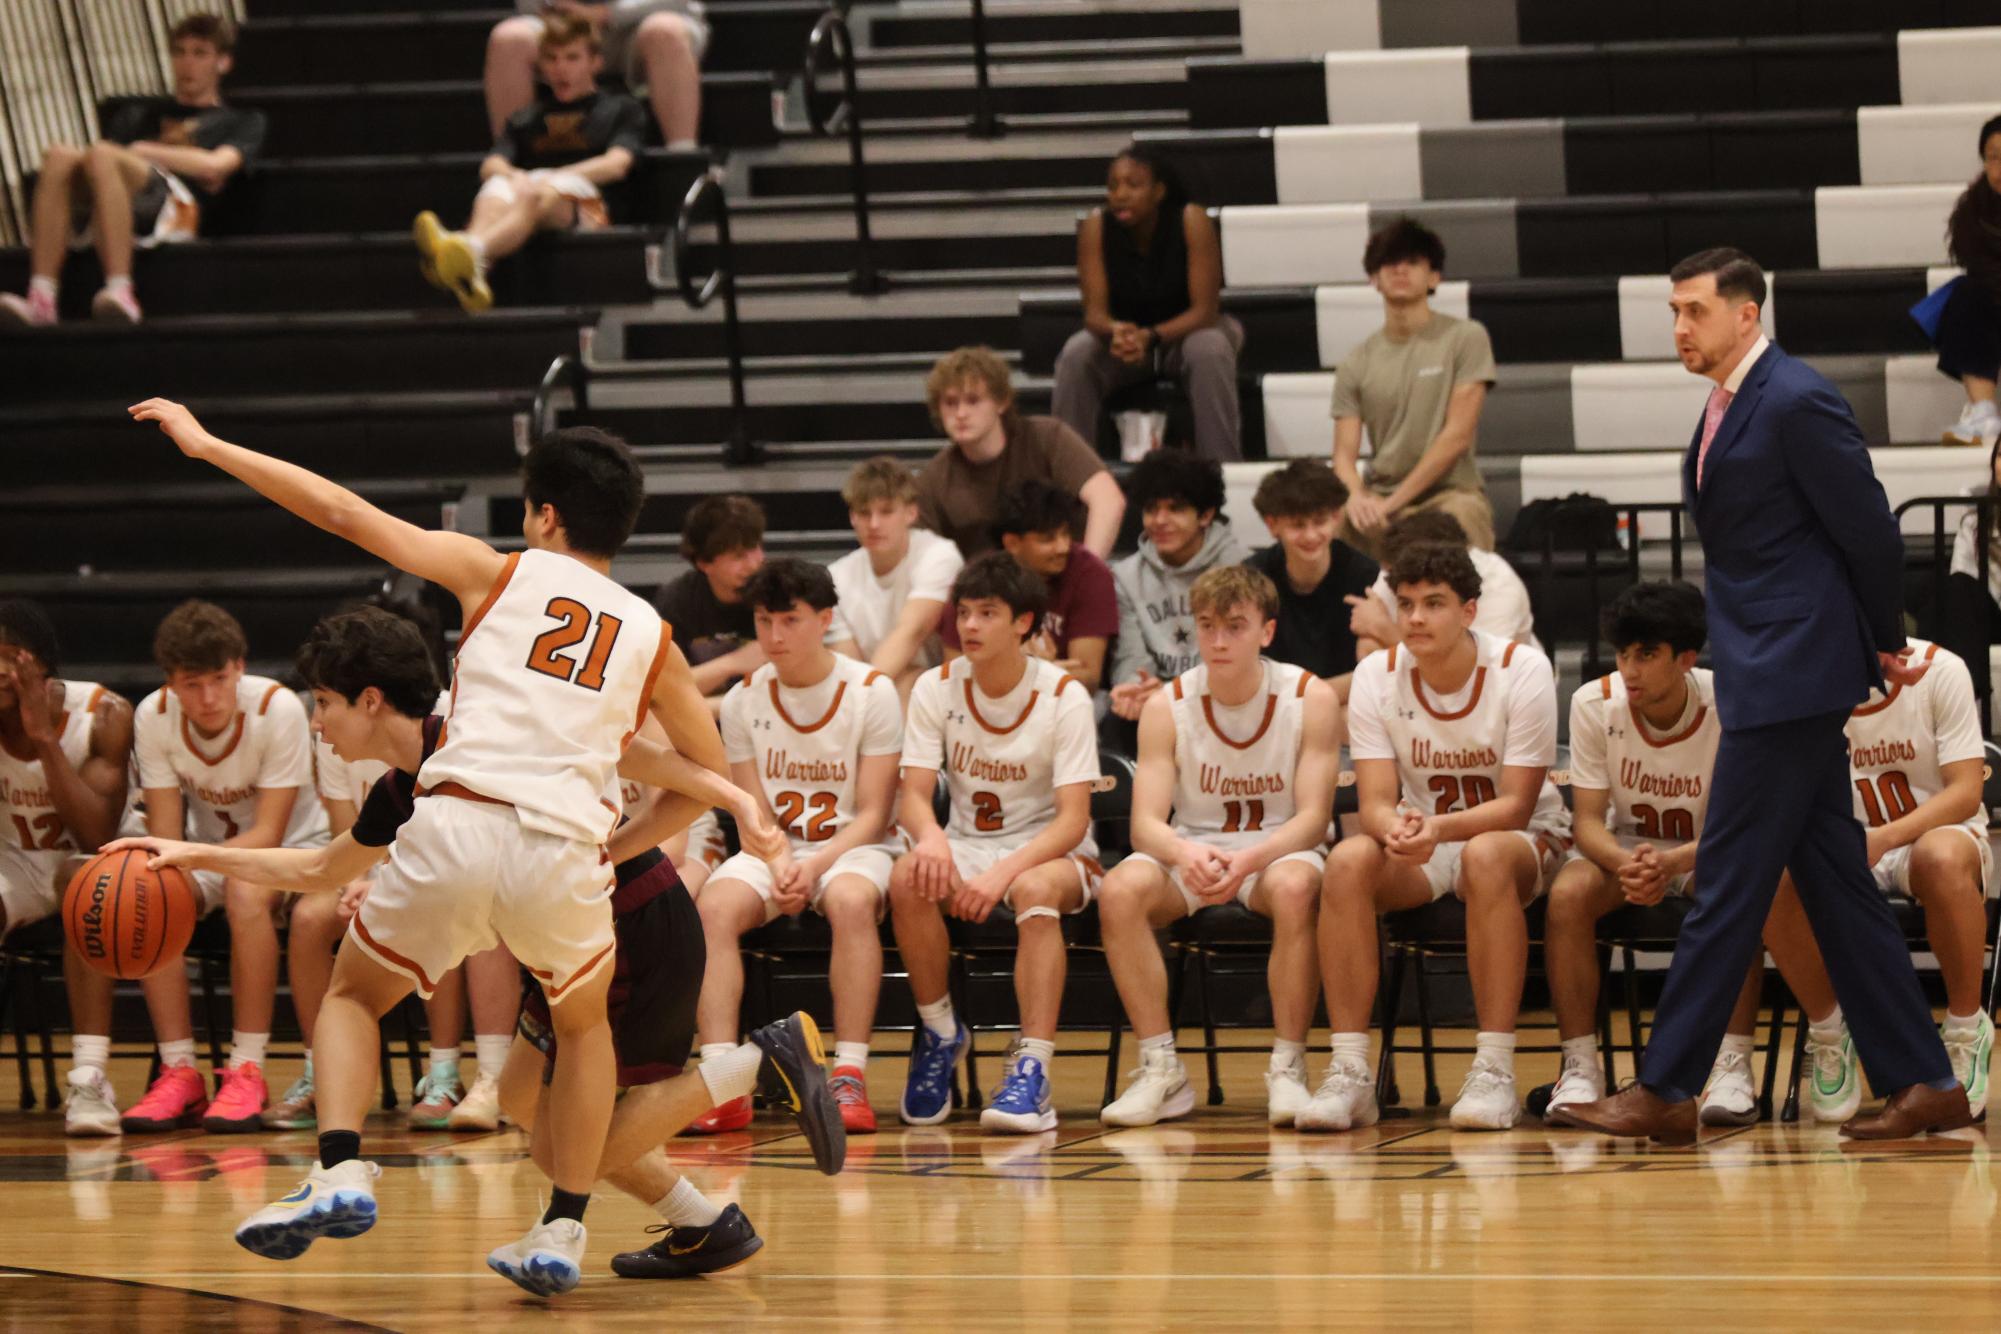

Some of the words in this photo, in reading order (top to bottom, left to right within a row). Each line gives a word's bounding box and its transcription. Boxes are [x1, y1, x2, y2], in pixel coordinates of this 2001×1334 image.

[1146, 594, 1193, 623] DALL
[525, 596, 623, 692] 21
[765, 747, 847, 782] Warriors
[953, 741, 1028, 782] Warriors
[1412, 737, 1497, 770] Warriors
[1848, 738, 1916, 768] arriors
[1200, 763, 1285, 797] Warriors
[1621, 757, 1702, 798] Warriors
[775, 791, 838, 842] 22
[971, 791, 1005, 832] 2
[1854, 770, 1918, 828] 10
[11, 813, 74, 851] 12
[83, 873, 113, 959] Wilson
